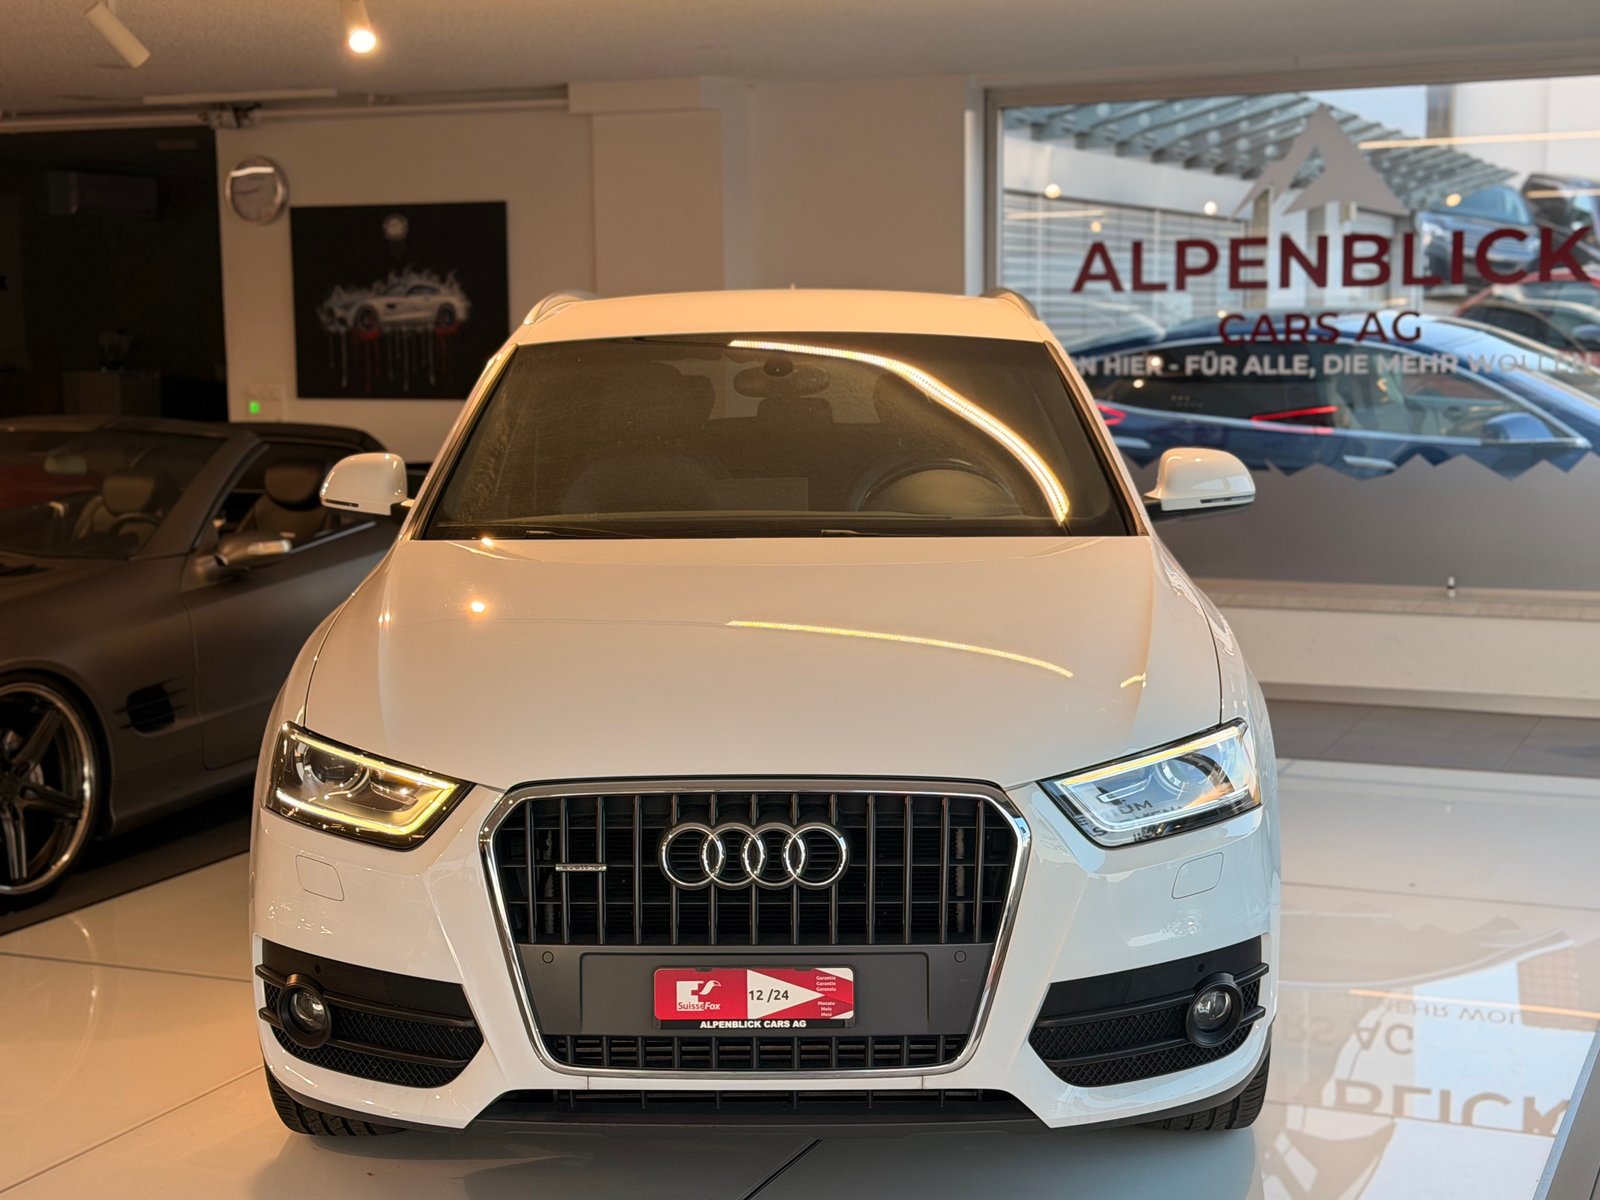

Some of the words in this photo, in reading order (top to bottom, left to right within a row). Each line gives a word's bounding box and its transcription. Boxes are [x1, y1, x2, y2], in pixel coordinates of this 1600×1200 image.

[1072, 226, 1592, 293] ALPENBLICK
[1218, 311, 1340, 346] CARS
[1355, 310, 1423, 342] AG
[1069, 355, 1097, 376] N
[1103, 354, 1163, 376] HIER
[1184, 351, 1238, 376] FÜR
[1243, 354, 1317, 379] ALLE,
[1323, 354, 1369, 376] DIE
[1376, 353, 1459, 375] MEHR
[748, 990, 764, 1001] 12
[766, 988, 790, 1003] /24
[700, 1020, 761, 1029] ALPENBLICK
[763, 1020, 790, 1028] CARS
[792, 1019, 807, 1028] AG
